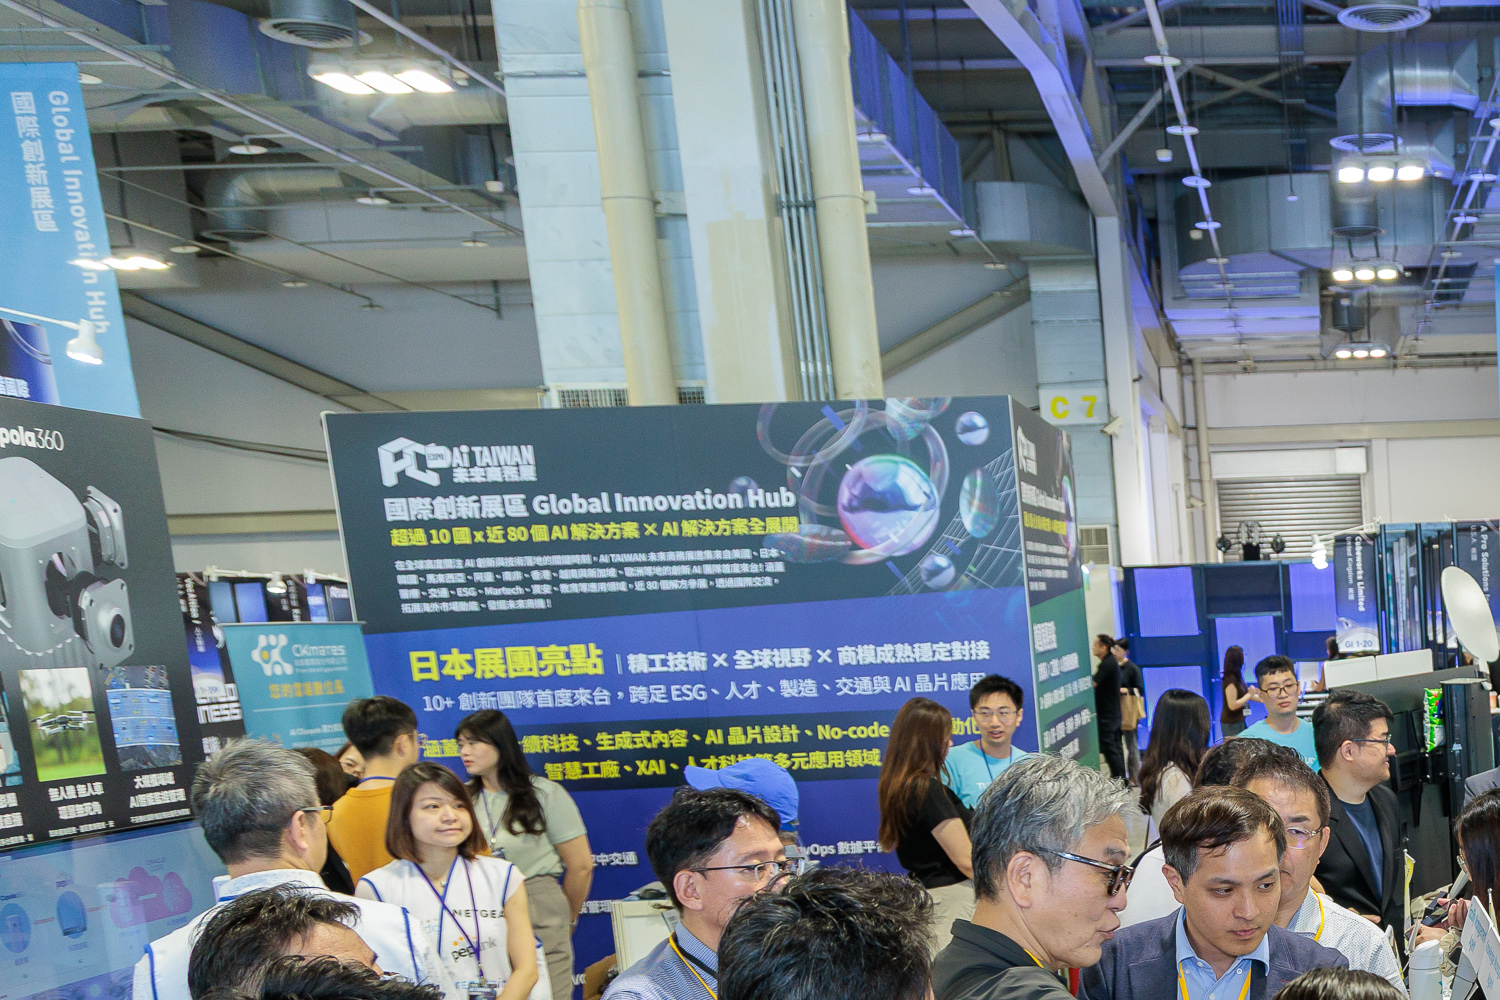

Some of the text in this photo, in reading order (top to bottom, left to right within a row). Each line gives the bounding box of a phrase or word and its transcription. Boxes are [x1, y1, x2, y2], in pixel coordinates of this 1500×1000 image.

[11, 91, 59, 232] 國際創新展區
[48, 90, 83, 166] Global
[85, 291, 111, 334] Hub
[1050, 395, 1098, 419] C 7
[471, 445, 536, 466] TAIWAN
[384, 487, 797, 521] 國際創新展區 Global Innovation Hub
[390, 528, 428, 546] 超過
[430, 528, 451, 545] 10
[486, 525, 506, 544] 近
[507, 526, 529, 542] 80
[551, 524, 568, 541] AI
[570, 521, 640, 541] 解決方案
[662, 522, 679, 537] AI
[681, 516, 799, 538] 解決方案全展開
[1480, 534, 1488, 551] Pro
[610, 552, 648, 563] TAIWAN
[1481, 552, 1490, 592] Solutions
[1357, 582, 1366, 612] Limited
[291, 644, 347, 657] CKmates
[1356, 640, 1372, 648] 1-20
[409, 643, 604, 682] 日本展團亮點
[627, 651, 708, 674] 精工技術
[733, 648, 812, 670] 全球視野
[837, 640, 990, 666] 商模成熟穩定對接
[423, 694, 454, 712] 10+
[894, 675, 911, 692] AI
[452, 908, 505, 918] NETGEA
